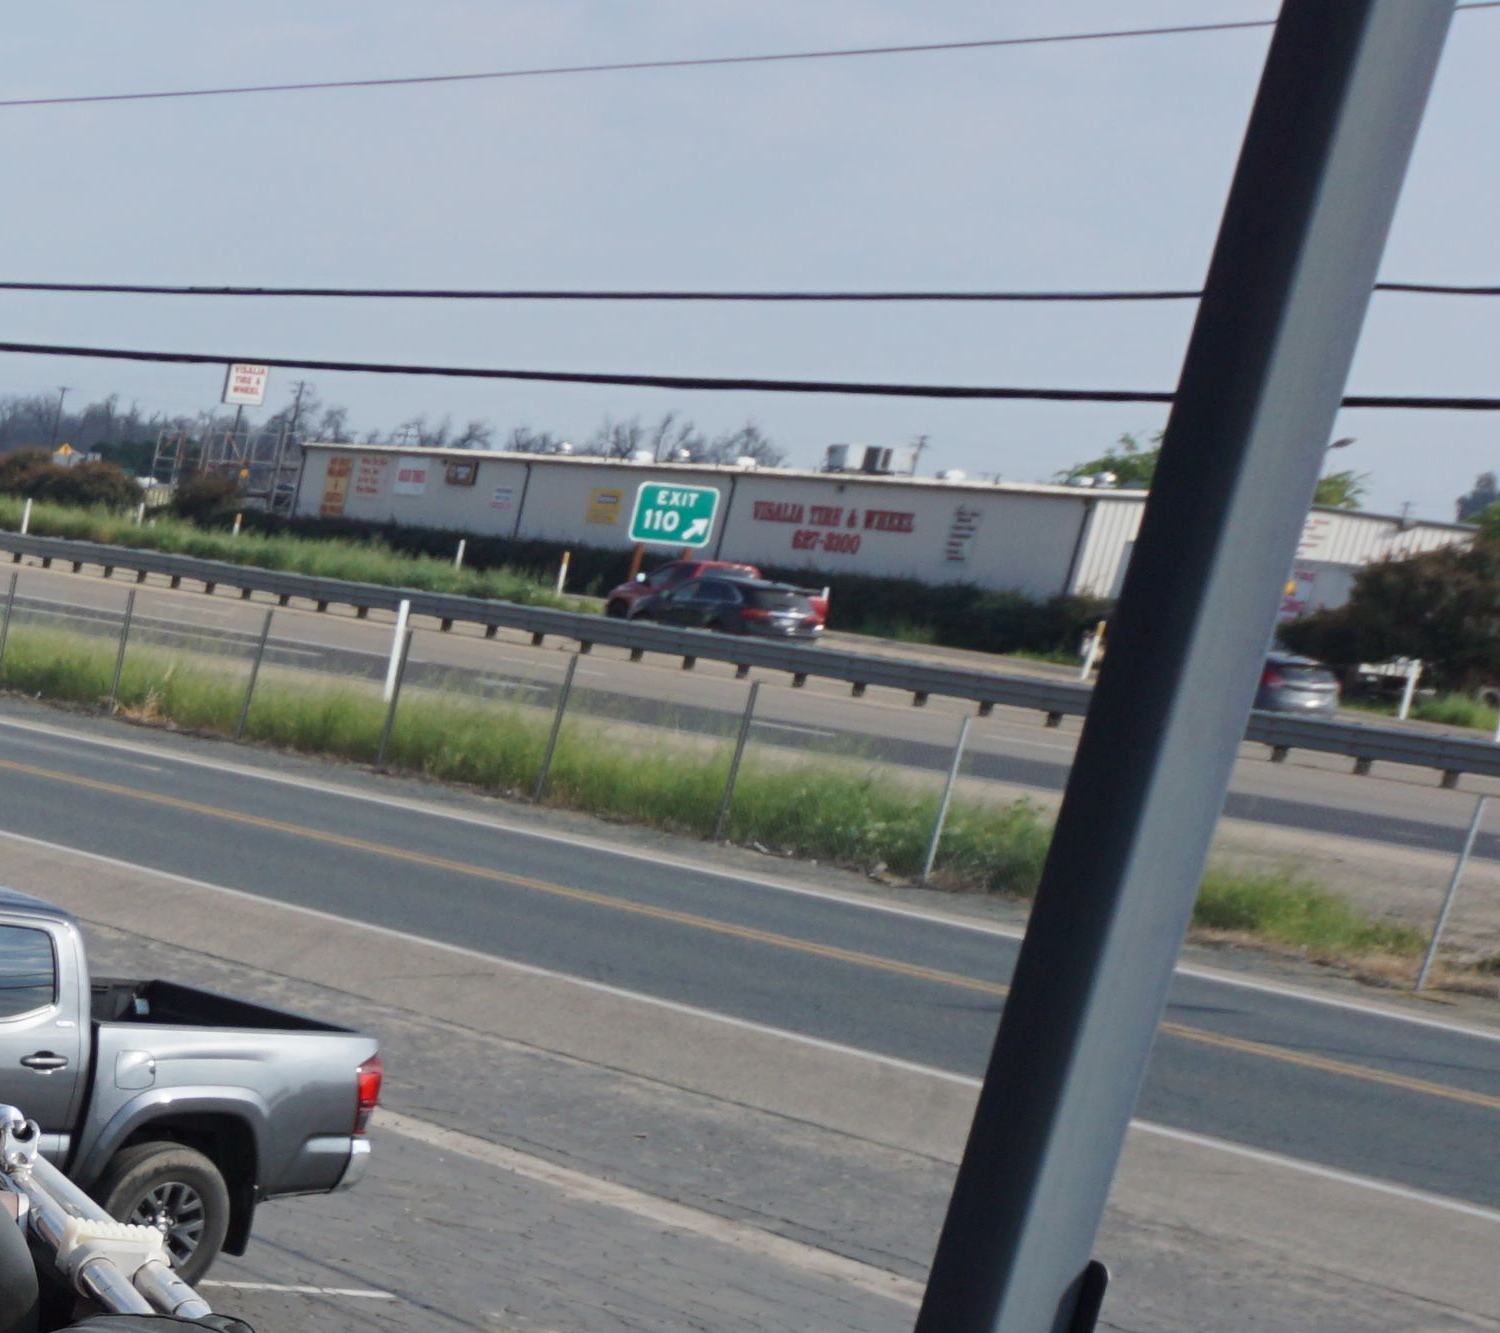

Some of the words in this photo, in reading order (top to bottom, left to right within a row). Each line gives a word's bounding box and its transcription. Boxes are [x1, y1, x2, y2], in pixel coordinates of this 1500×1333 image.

[657, 490, 700, 508] EXIT
[643, 509, 681, 532] 110
[754, 501, 805, 524] VISALIA
[809, 505, 844, 527] TIRE
[863, 509, 916, 533] WHEEL
